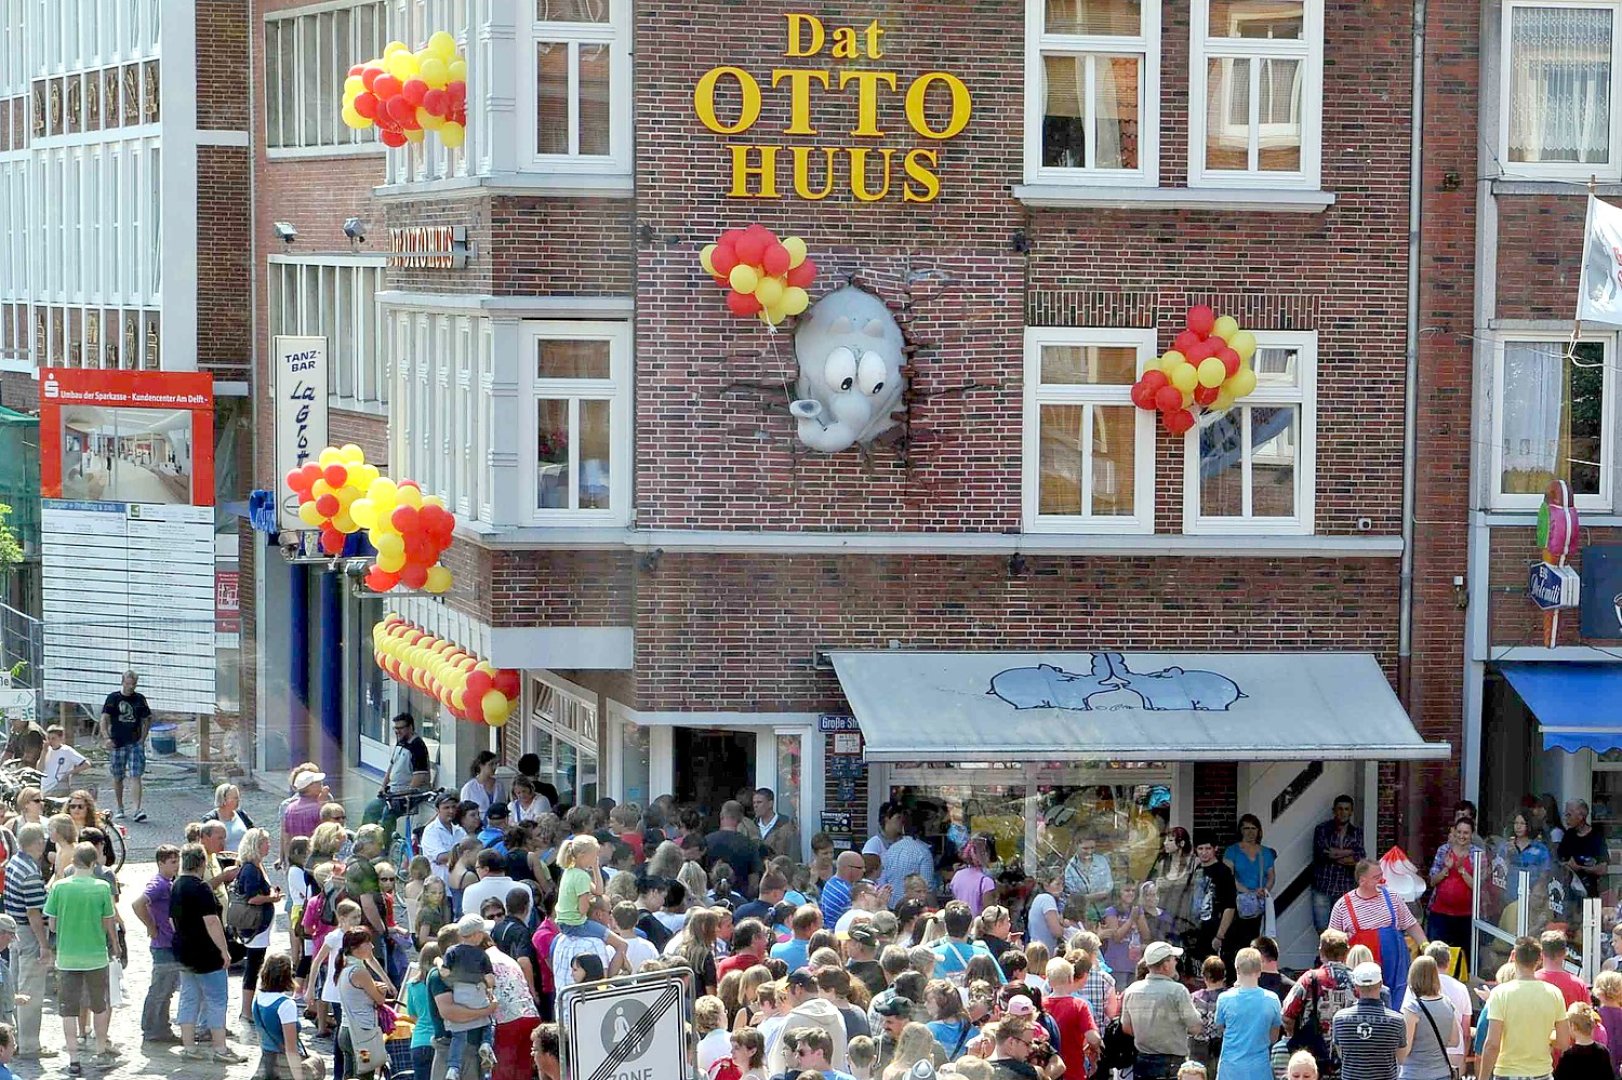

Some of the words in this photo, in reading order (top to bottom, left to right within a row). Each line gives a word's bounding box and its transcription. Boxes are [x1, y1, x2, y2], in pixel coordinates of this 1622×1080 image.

[784, 13, 885, 59] Dat
[693, 66, 972, 139] OTTO
[725, 145, 941, 203] HUUS
[291, 360, 316, 372] BAR
[60, 391, 82, 399] Umbau
[83, 391, 95, 399] der
[95, 391, 127, 401] Sparkasse
[132, 393, 175, 402] Kundencenter
[176, 395, 187, 403] Am
[188, 395, 203, 403] Delft
[822, 717, 845, 730] Große
